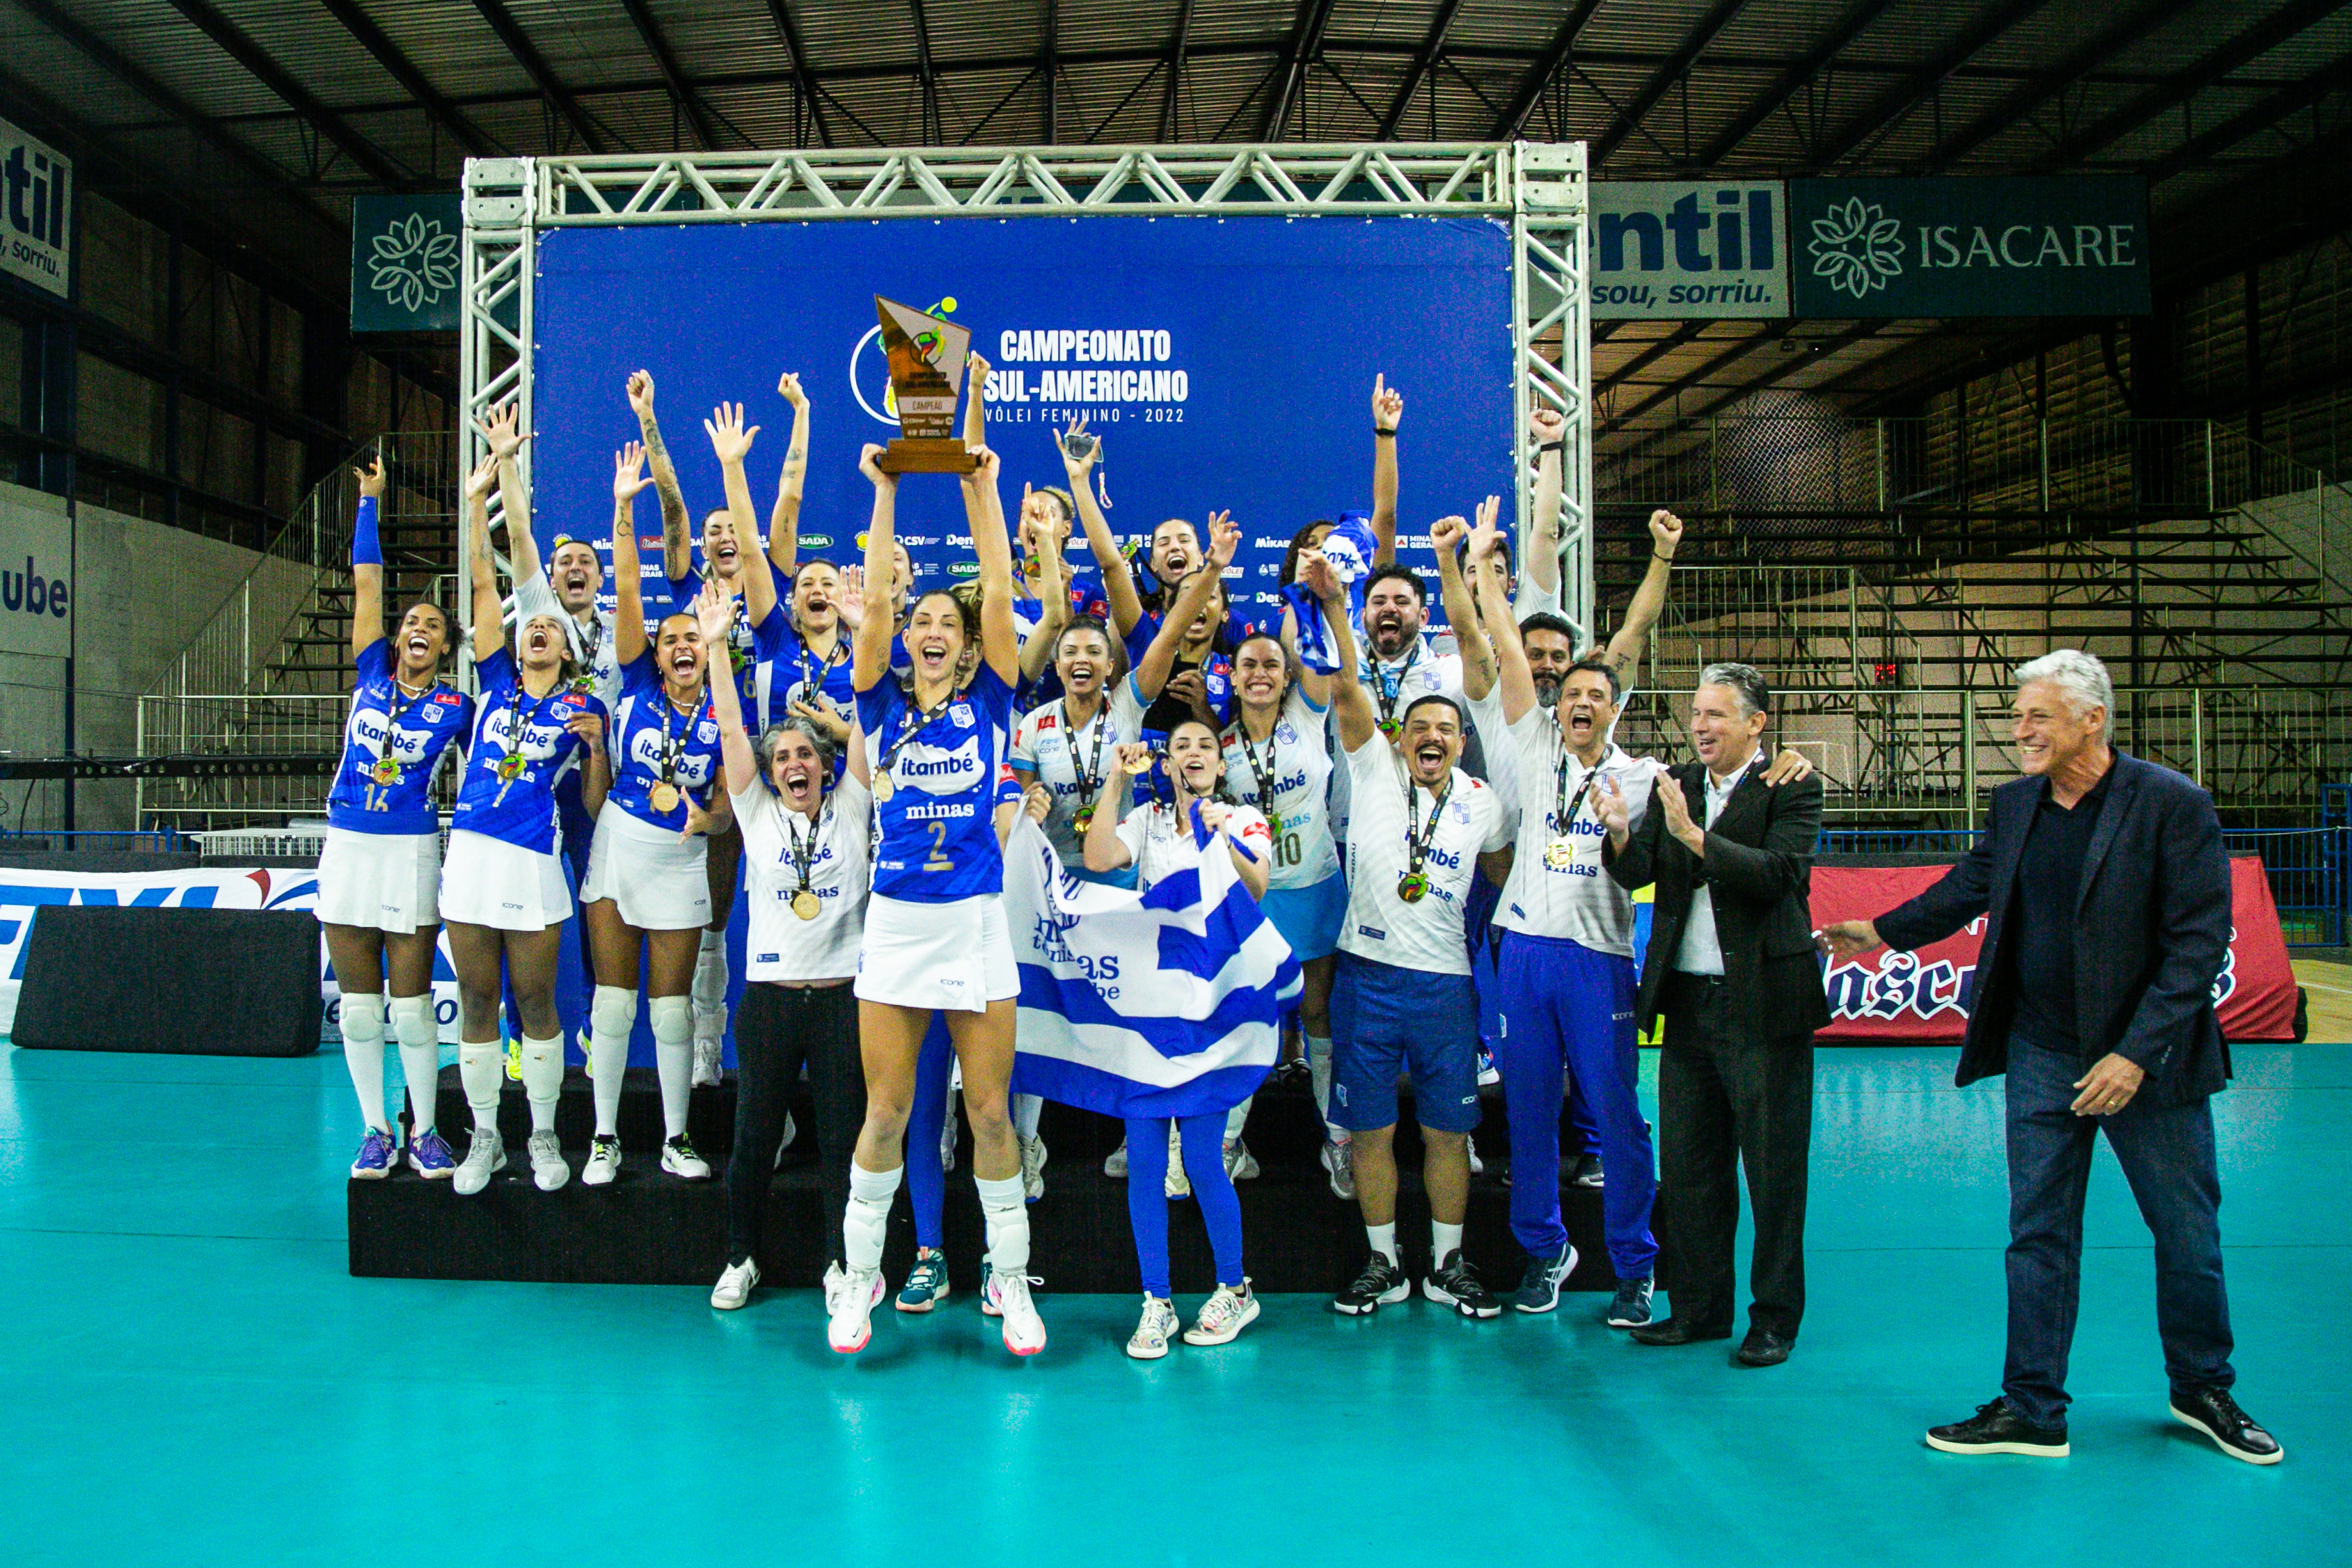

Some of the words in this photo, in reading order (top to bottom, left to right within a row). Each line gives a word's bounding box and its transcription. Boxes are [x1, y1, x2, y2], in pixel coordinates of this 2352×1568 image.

[0, 145, 65, 251] til
[1589, 191, 1774, 272] ntil
[1919, 224, 2136, 268] ISACARE
[12, 241, 60, 278] sorriu.
[1589, 284, 1657, 308] sou,
[1668, 278, 1771, 304] sorriu.
[1000, 329, 1171, 362] CAMPEONATO
[983, 370, 1189, 402] SUL-AMERICANO
[985, 406, 1032, 422] VÔLEI
[1042, 408, 1120, 422] FEMININO
[1146, 408, 1184, 422] 2022
[798, 537, 828, 545] SADA
[905, 536, 926, 546] CSV
[491, 718, 548, 748] itabé
[639, 738, 700, 779] itabé
[901, 752, 974, 776] itambé
[906, 801, 974, 819] minas
[927, 821, 948, 862] 2
[1273, 832, 1302, 868] 10
[503, 902, 524, 910] icone
[940, 979, 965, 987] icone
